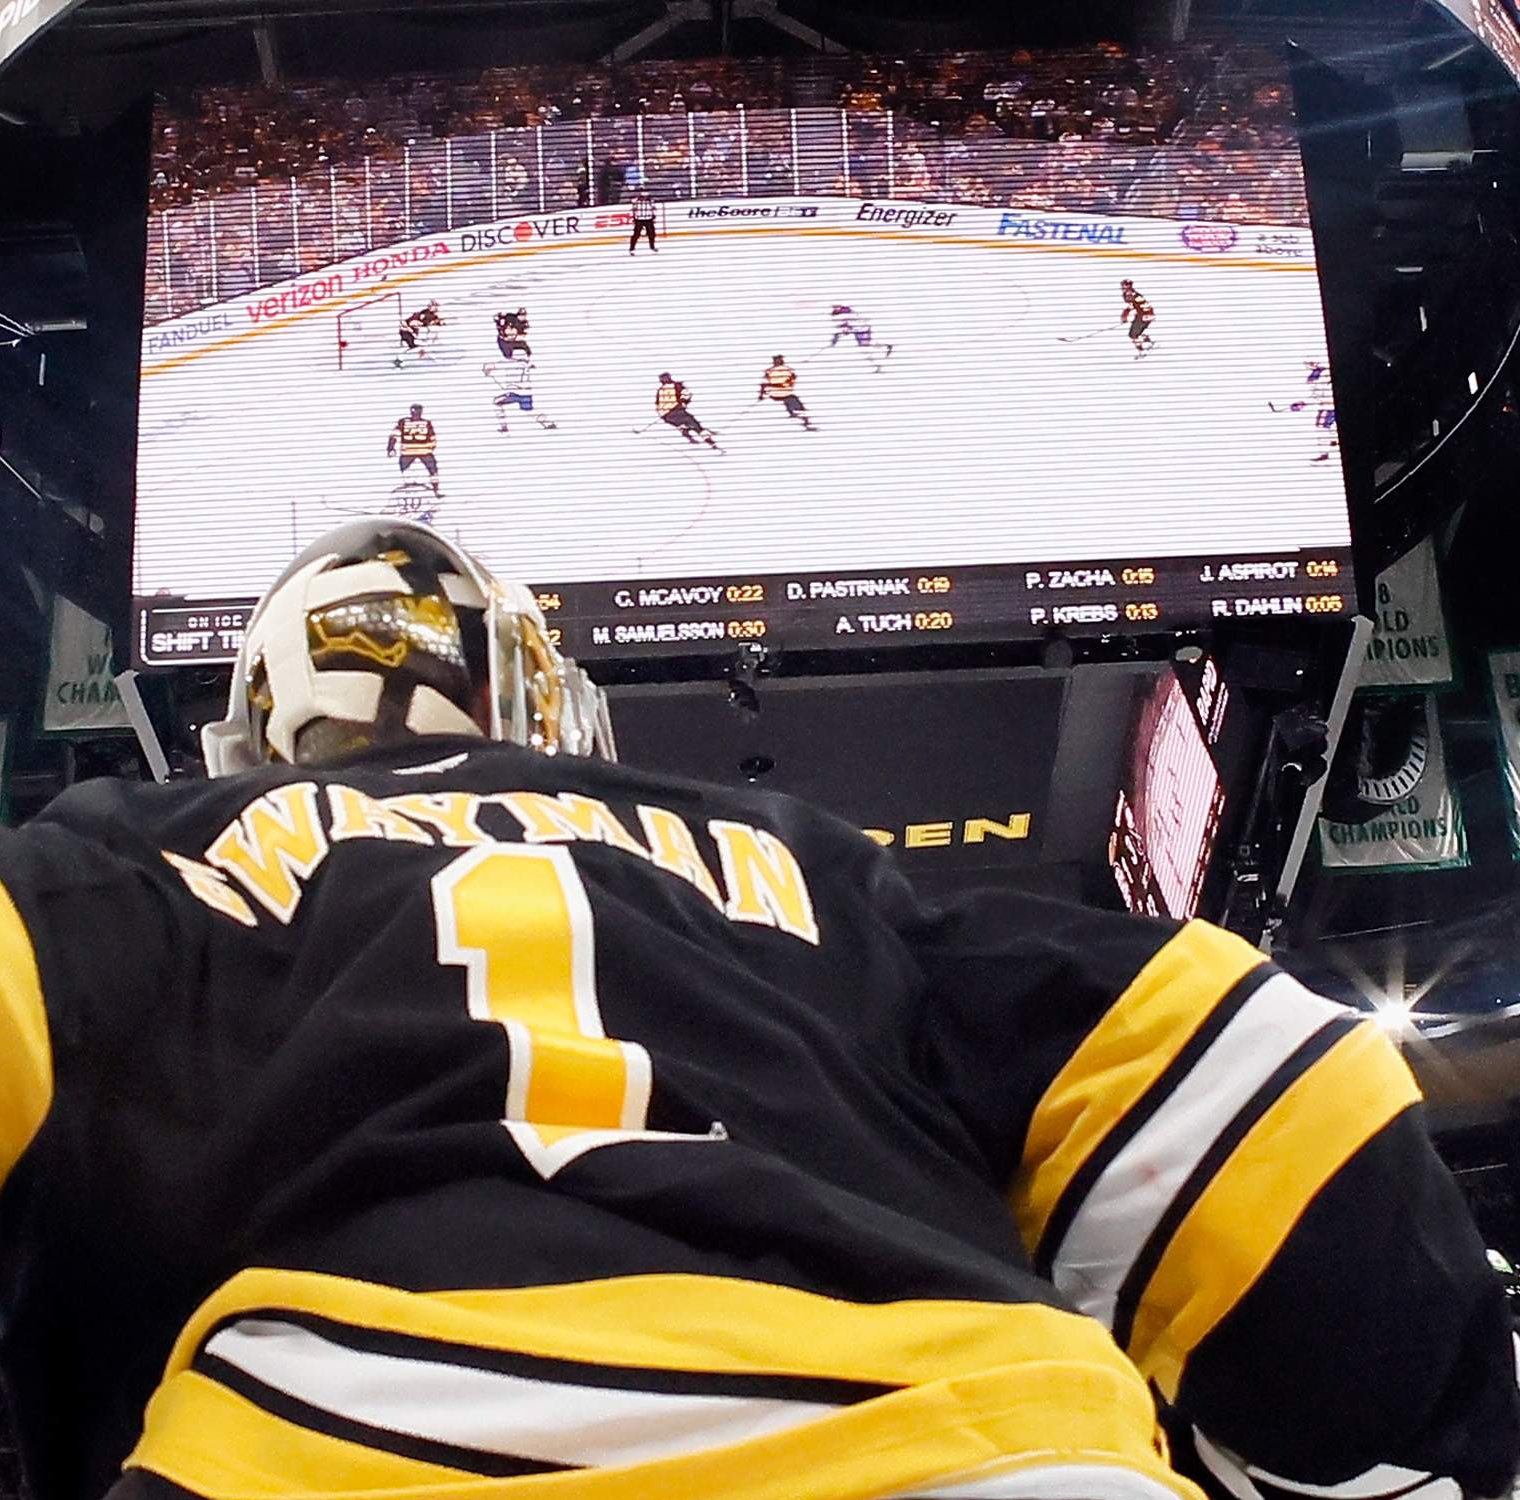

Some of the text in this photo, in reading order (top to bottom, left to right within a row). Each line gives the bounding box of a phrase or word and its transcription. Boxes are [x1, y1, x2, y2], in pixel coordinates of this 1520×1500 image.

[855, 202, 958, 228] Energizer
[460, 216, 580, 254] DISCOVER
[996, 213, 1128, 245] FASTENAL
[352, 241, 451, 285] HONDA
[245, 273, 344, 325] verizon
[147, 313, 233, 355] FANDUEL
[1025, 571, 1045, 590] P.
[1048, 568, 1116, 589] ZACHA
[1217, 560, 1299, 582] ASPIROT
[638, 586, 723, 608] MCAVOY
[726, 584, 764, 603] 0:22
[786, 582, 807, 600] D.
[809, 577, 911, 600] PASTRNAK
[536, 593, 562, 611] 54
[1234, 595, 1303, 616] DAHLIN
[187, 615, 210, 629] ON
[835, 611, 953, 634] A. TUCH 0:20
[1030, 606, 1049, 626] P.
[1052, 603, 1119, 624] KREBS
[150, 630, 214, 653] SHIFT
[592, 619, 766, 645] M. SAMUELSSON 0:30
[1328, 815, 1449, 845] CHAMPIONS
[430, 841, 728, 1181] 1
